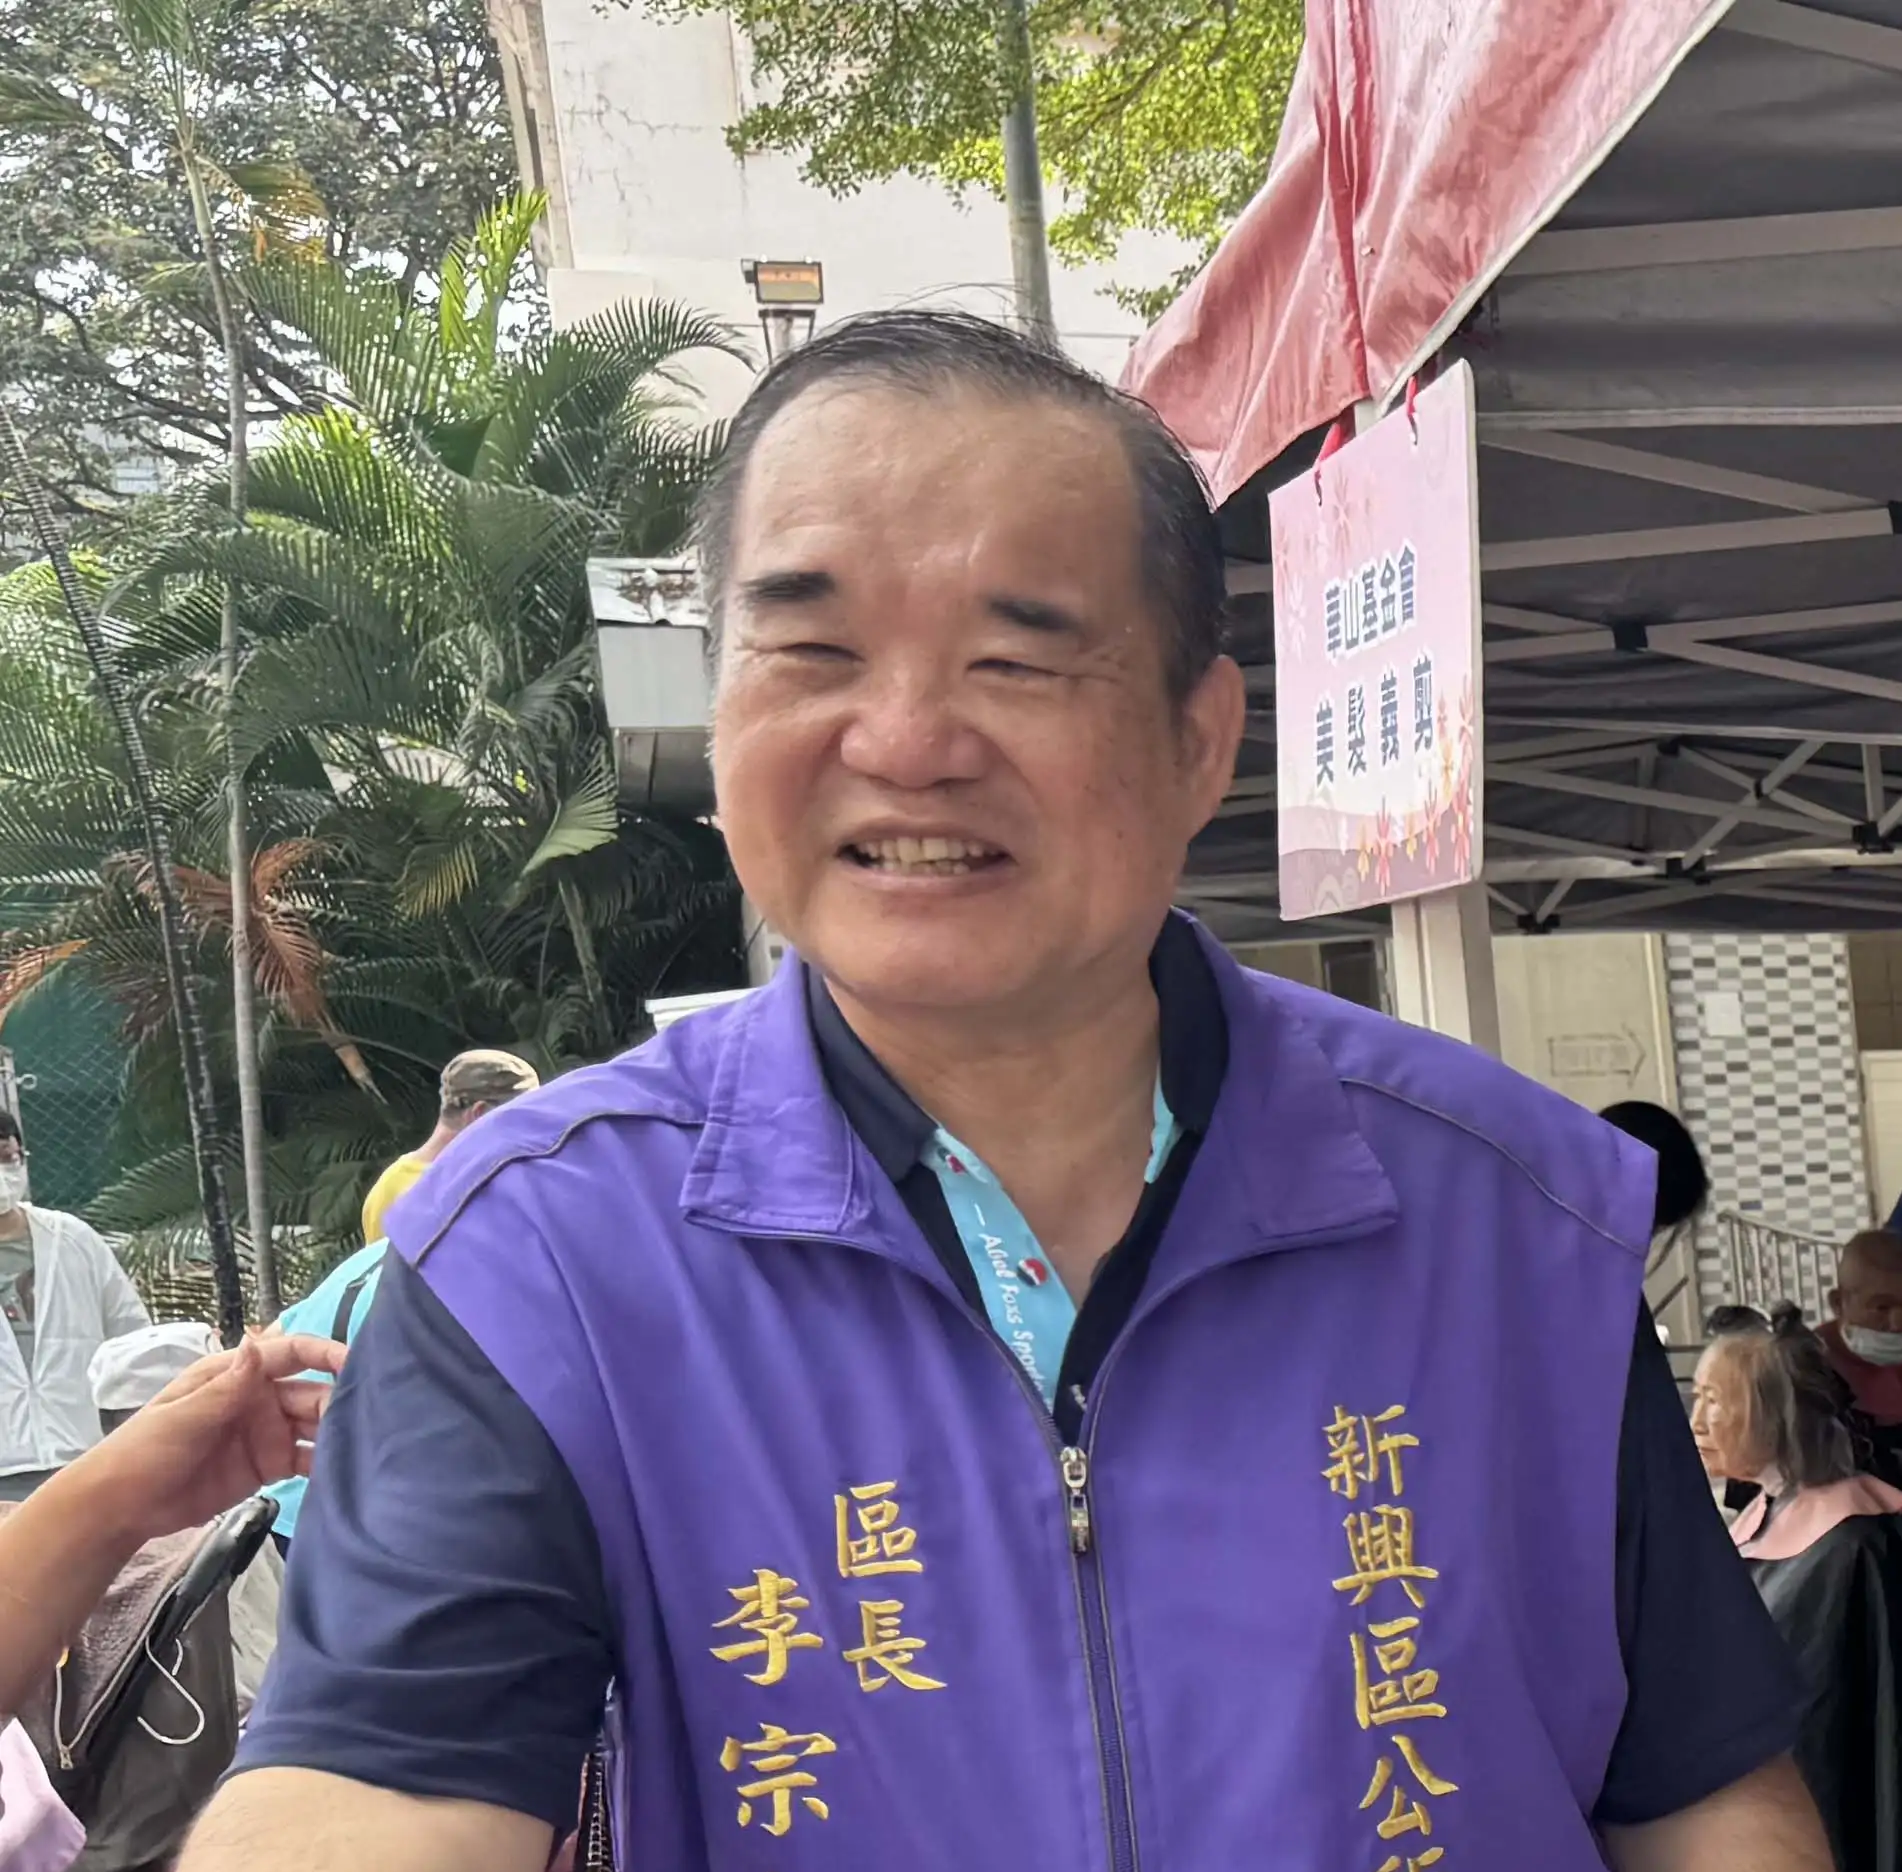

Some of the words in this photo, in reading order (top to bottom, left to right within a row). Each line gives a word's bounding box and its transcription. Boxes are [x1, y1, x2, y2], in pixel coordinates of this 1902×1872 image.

[1325, 545, 1415, 657] 華山基金會
[1315, 656, 1434, 787] 美髮義剪
[833, 1480, 947, 1693] 區長
